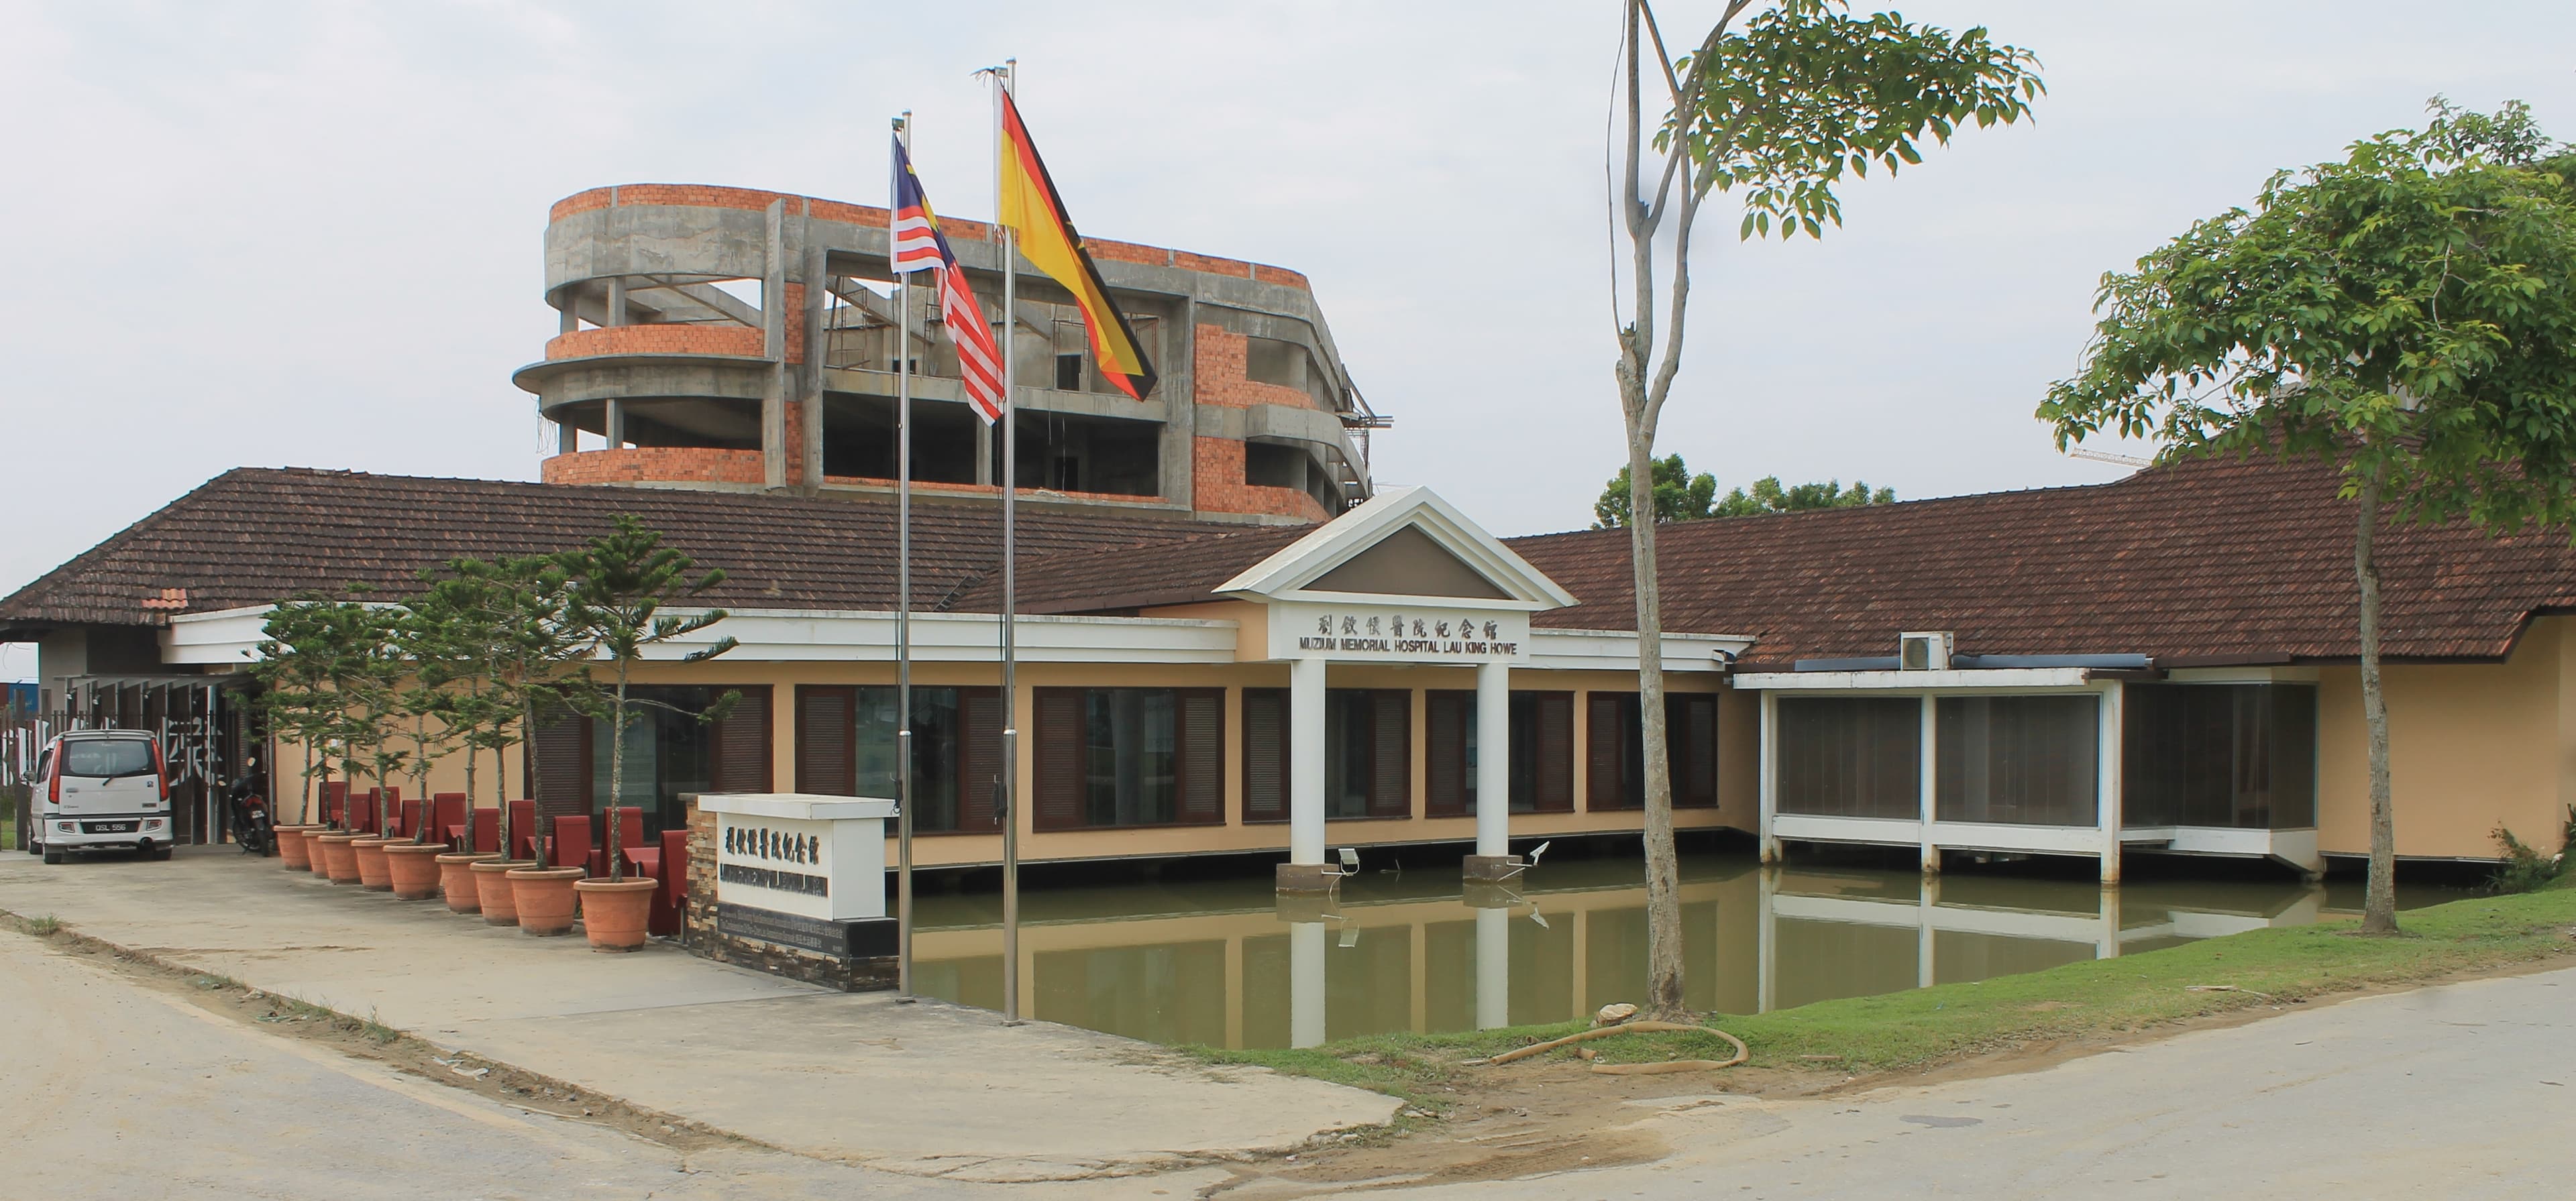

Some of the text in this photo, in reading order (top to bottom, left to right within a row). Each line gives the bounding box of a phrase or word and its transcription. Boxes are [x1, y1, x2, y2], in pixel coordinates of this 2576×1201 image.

[1299, 637, 1517, 655] MUZIUM MEMORIAL HOSPITAL LAU KING HOWE
